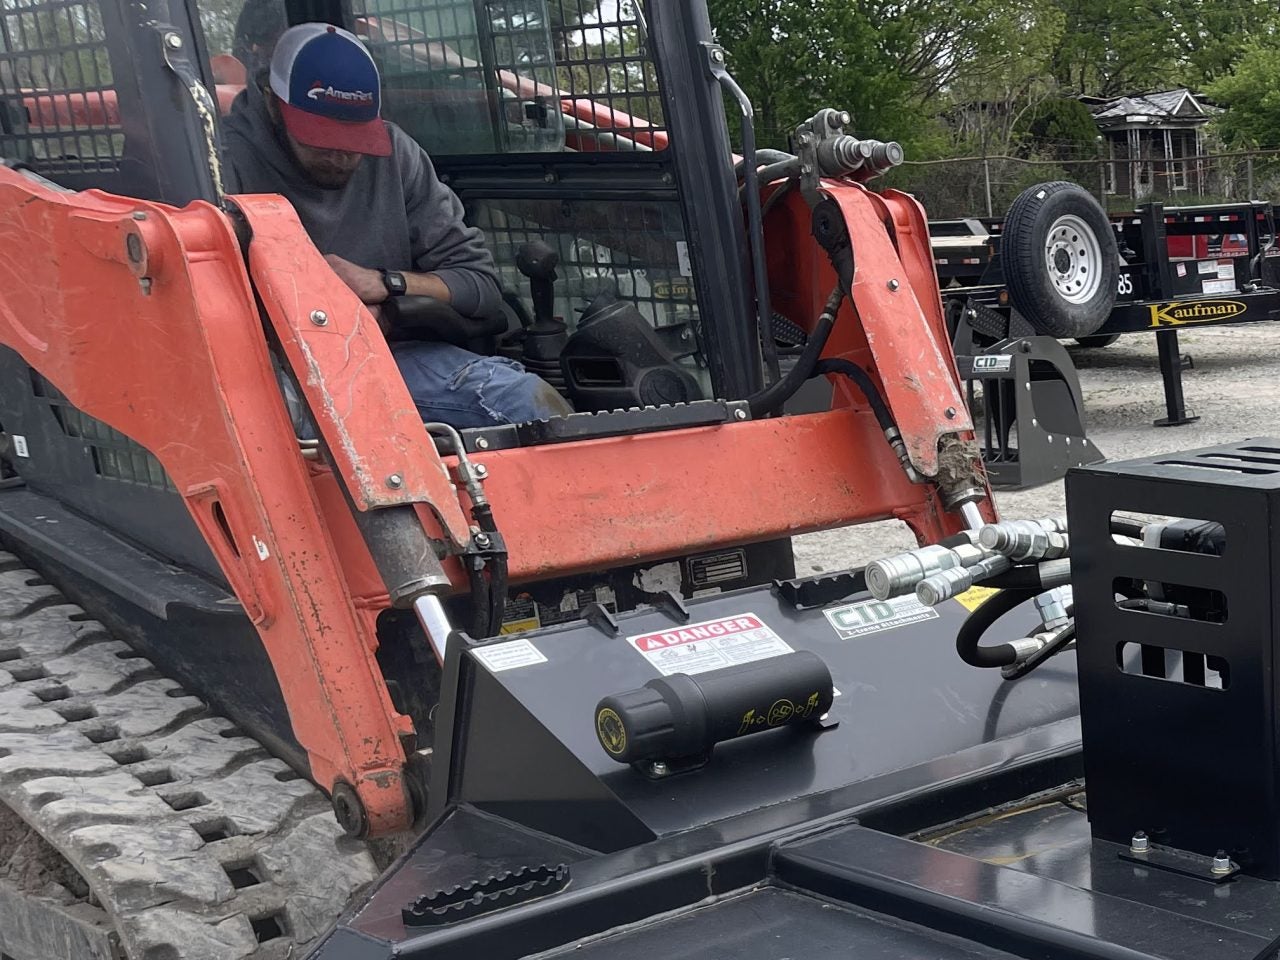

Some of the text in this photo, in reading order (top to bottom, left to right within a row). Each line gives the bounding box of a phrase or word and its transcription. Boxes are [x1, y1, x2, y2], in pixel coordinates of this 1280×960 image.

[1146, 302, 1238, 327] Kaufman
[975, 357, 998, 367] CID
[831, 602, 897, 630] CID
[661, 617, 754, 646] DANGER
